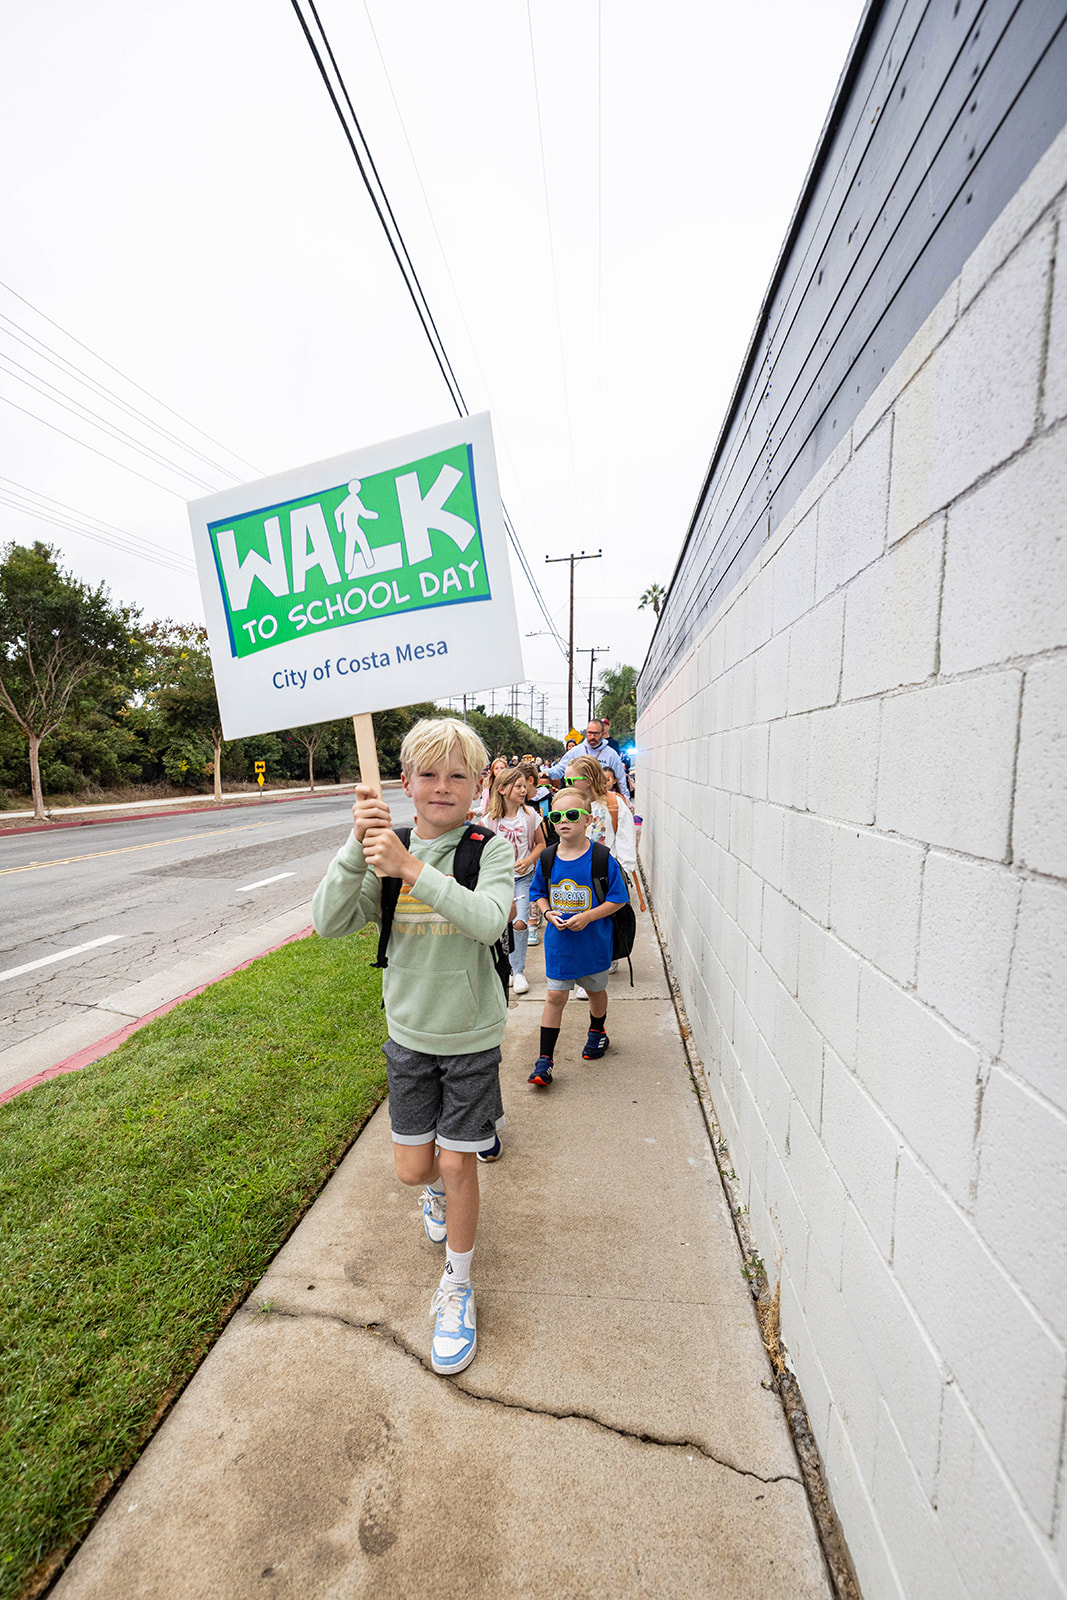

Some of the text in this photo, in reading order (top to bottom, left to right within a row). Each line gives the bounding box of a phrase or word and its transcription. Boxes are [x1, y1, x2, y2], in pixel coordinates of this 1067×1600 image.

[216, 463, 476, 612] WALK
[242, 559, 479, 644] TO SCHOOL DAY
[272, 640, 448, 690] City of Costa Mesa
[552, 890, 586, 904] COUGARS
[429, 923, 462, 936] YARD
